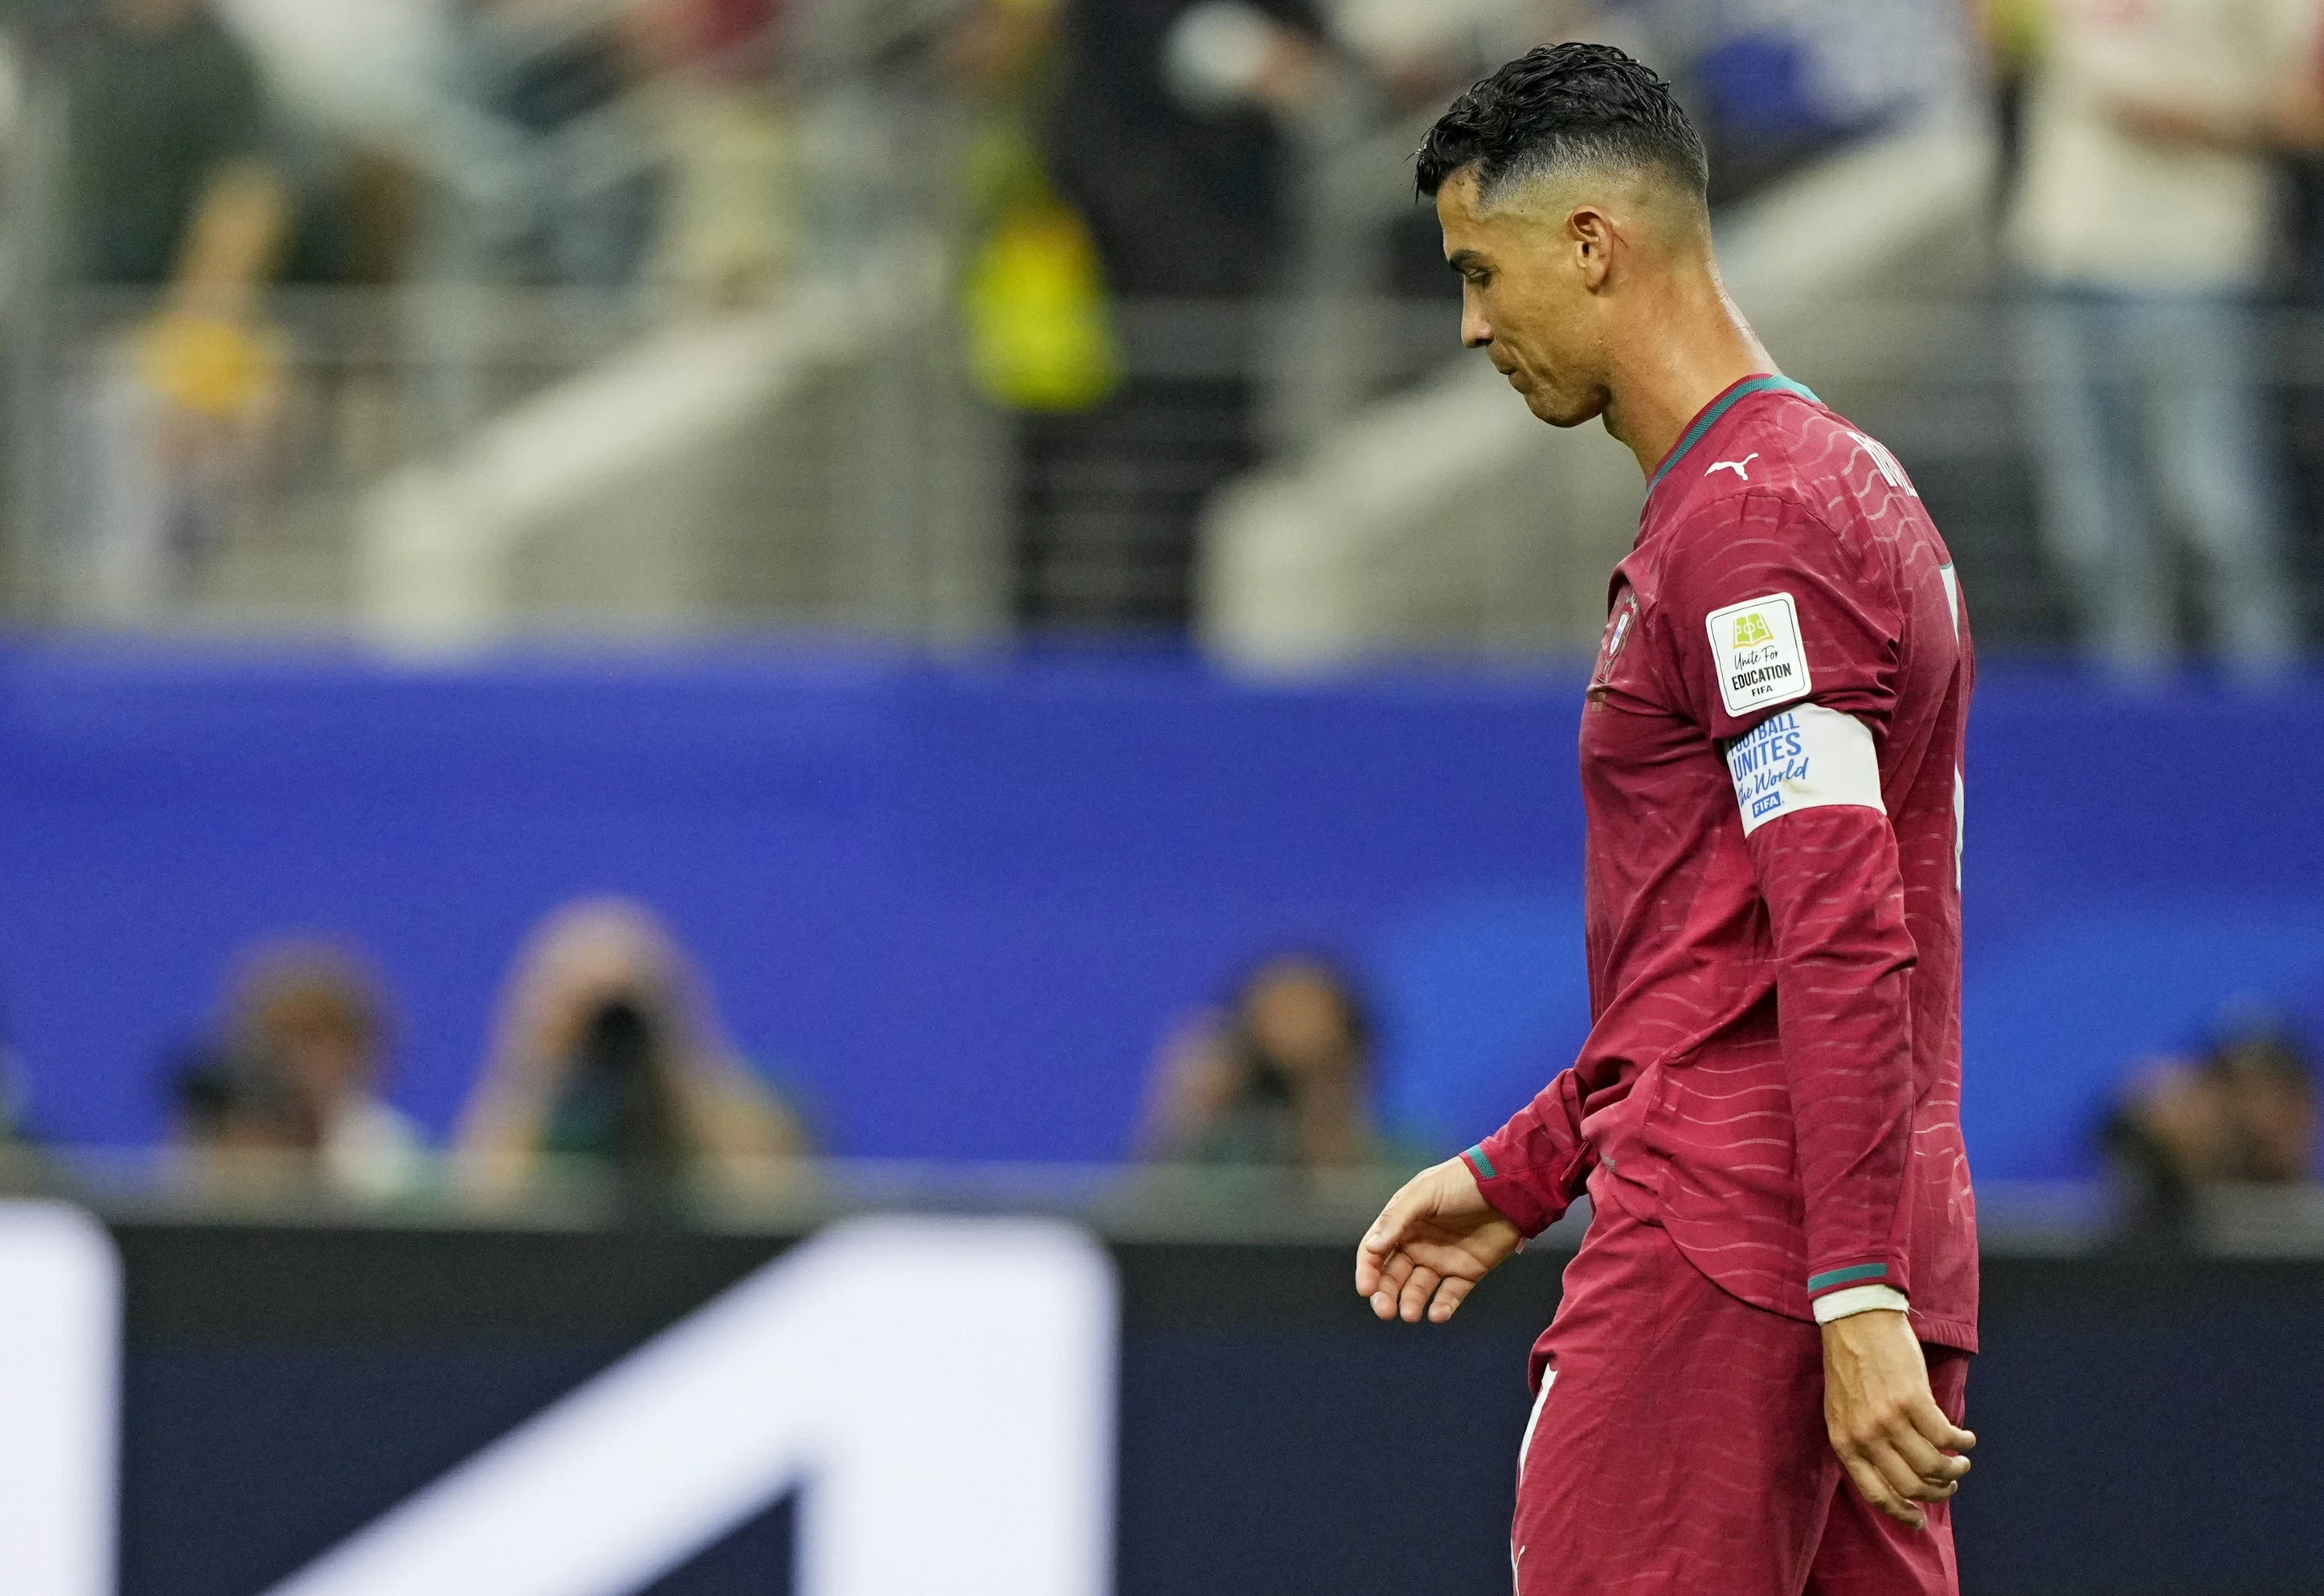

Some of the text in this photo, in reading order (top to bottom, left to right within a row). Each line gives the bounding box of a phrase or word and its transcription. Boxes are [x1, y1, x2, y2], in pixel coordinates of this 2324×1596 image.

[1734, 645, 1779, 671] Unite For
[1731, 662, 1792, 691] EDUCATION
[1751, 685, 1774, 698] FIFA
[1733, 731, 1802, 782] UNITES
[1738, 756, 1810, 808] the World
[1753, 792, 1780, 818] FIFA
